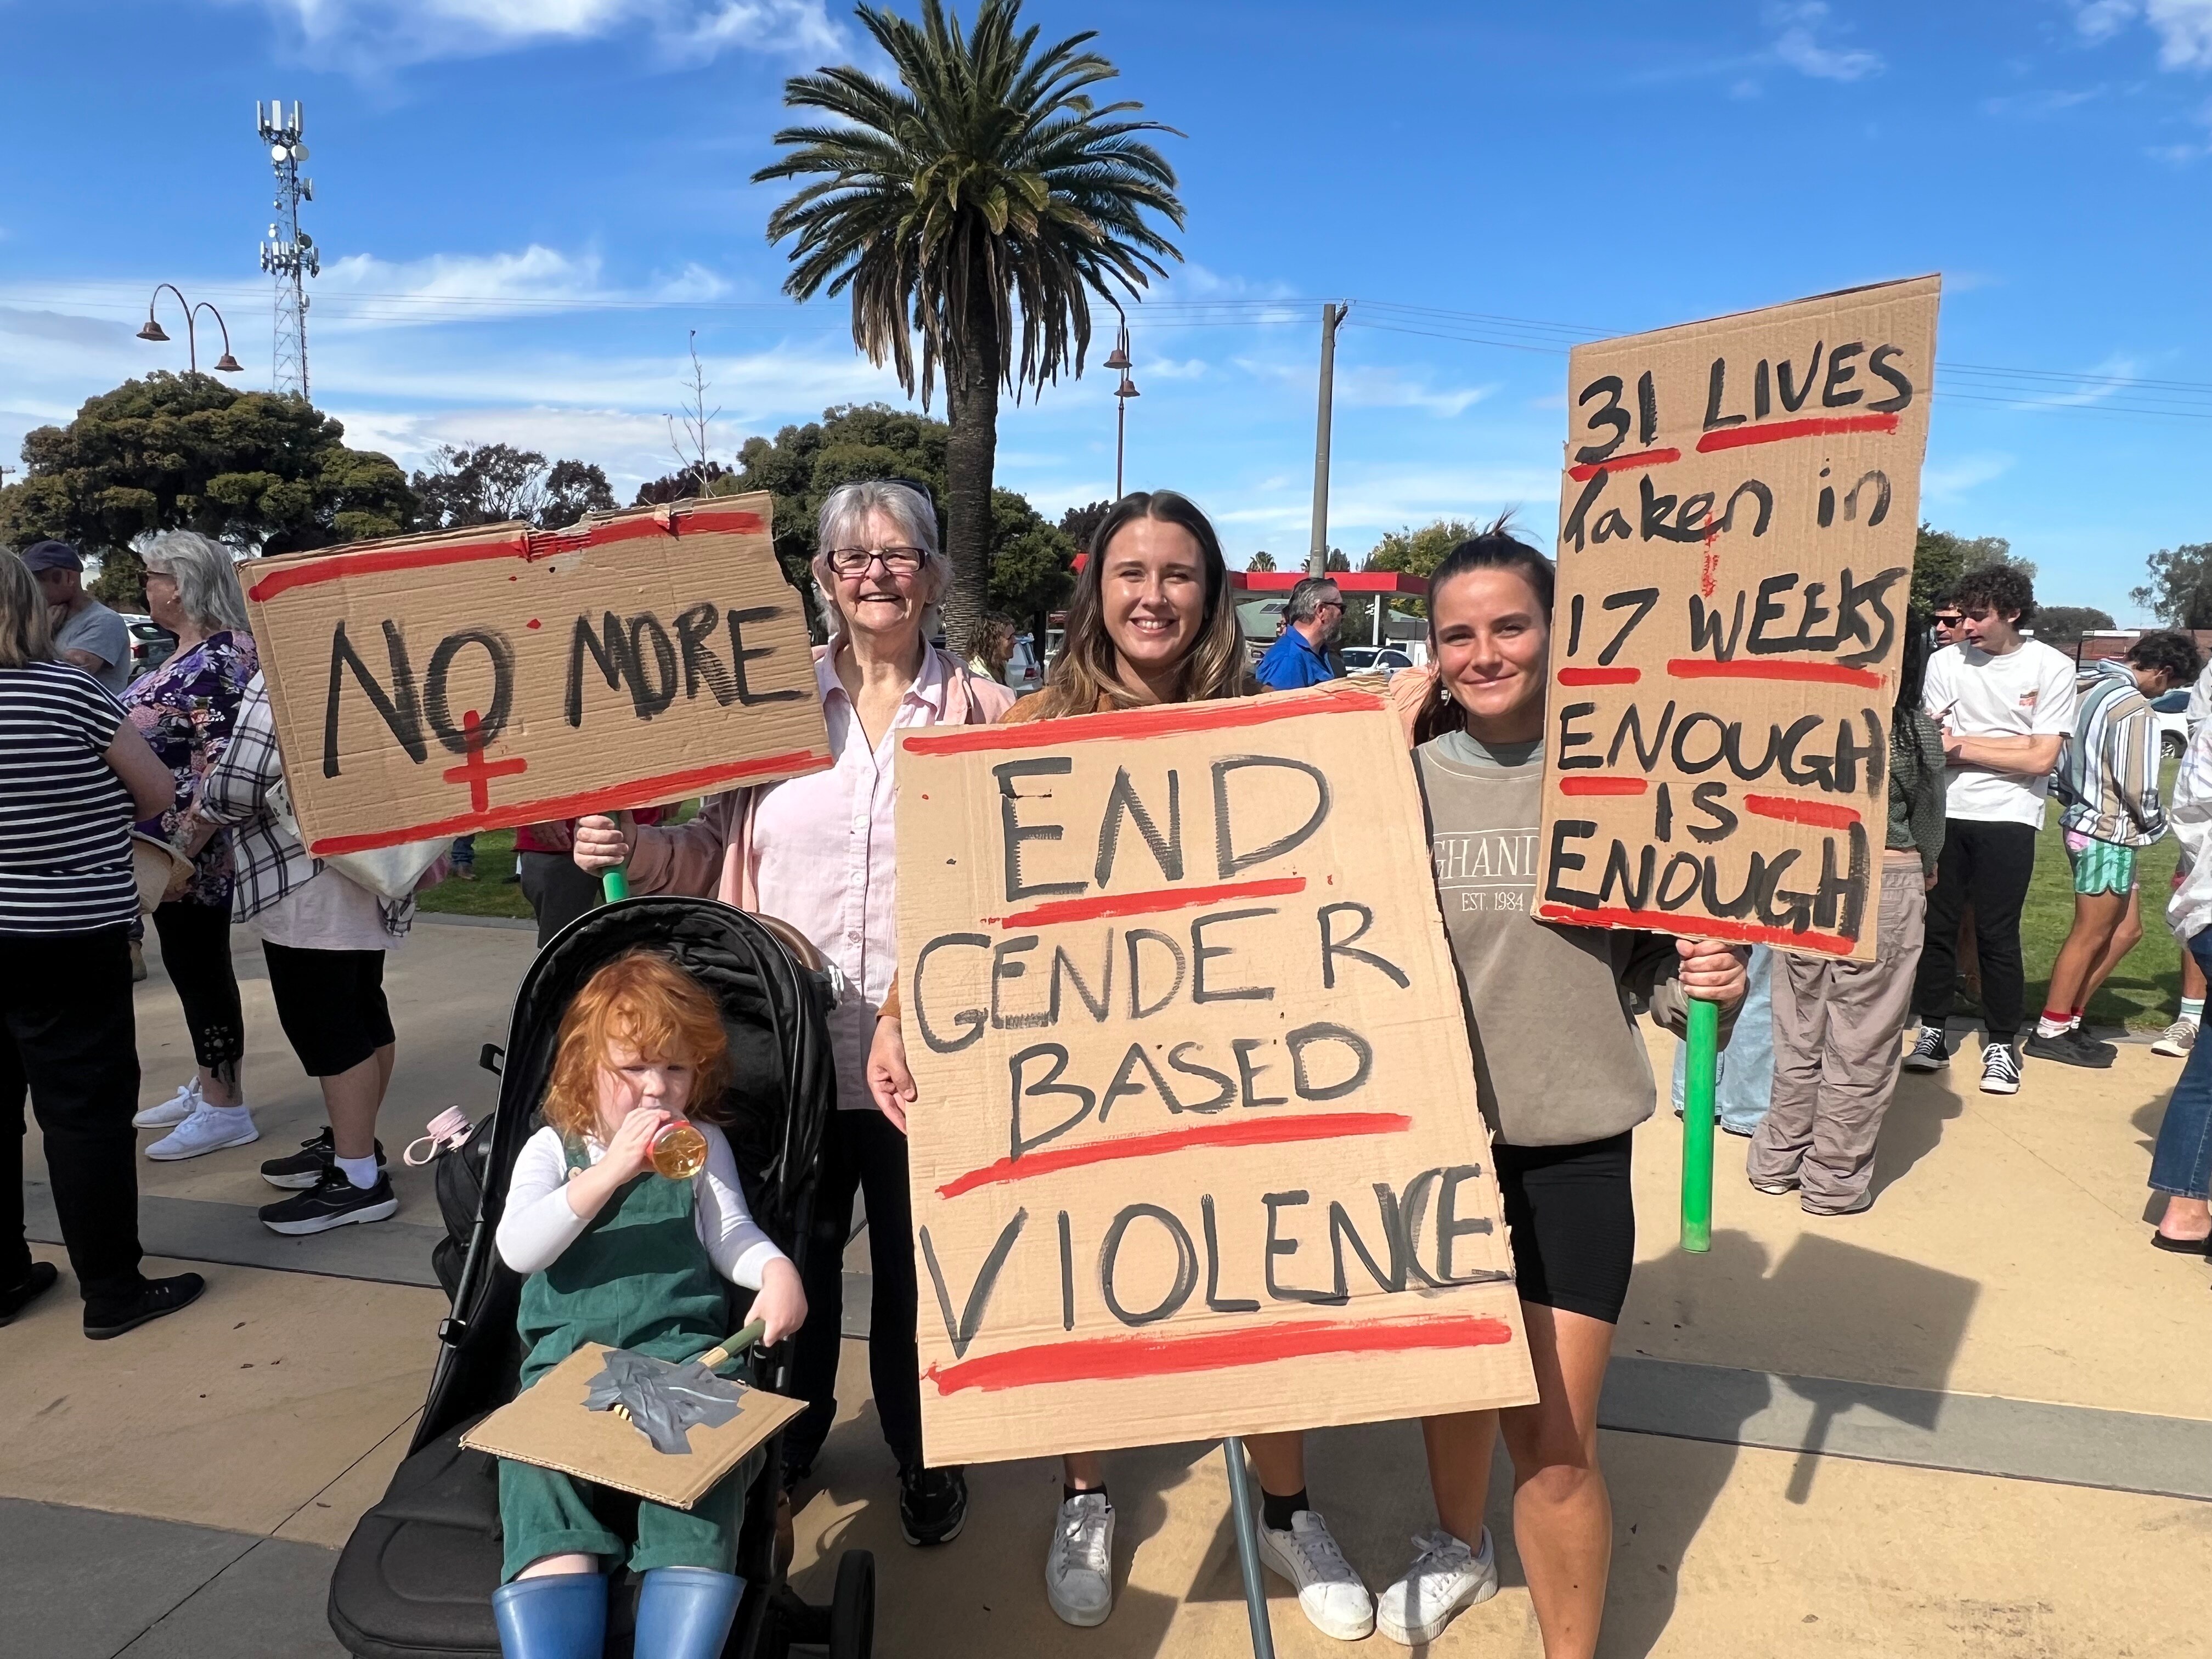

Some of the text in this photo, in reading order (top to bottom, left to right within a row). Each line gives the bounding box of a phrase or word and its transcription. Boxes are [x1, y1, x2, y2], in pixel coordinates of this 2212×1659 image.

[1575, 340, 1913, 464] 31 LIVES
[1817, 466, 1891, 528] in
[1567, 567, 1910, 668] 17 WEEKS
[324, 602, 813, 779] NO MORE
[1558, 701, 1886, 799] ENOUGH
[992, 754, 1332, 901] END
[1655, 782, 1738, 844] IS
[1494, 891, 1523, 912] 1984
[1545, 820, 1870, 943] ENOUGH
[914, 901, 1410, 1053] GENDER
[1009, 1022, 1373, 1161] BASED
[919, 1164, 1516, 1359] VIOLENCE
